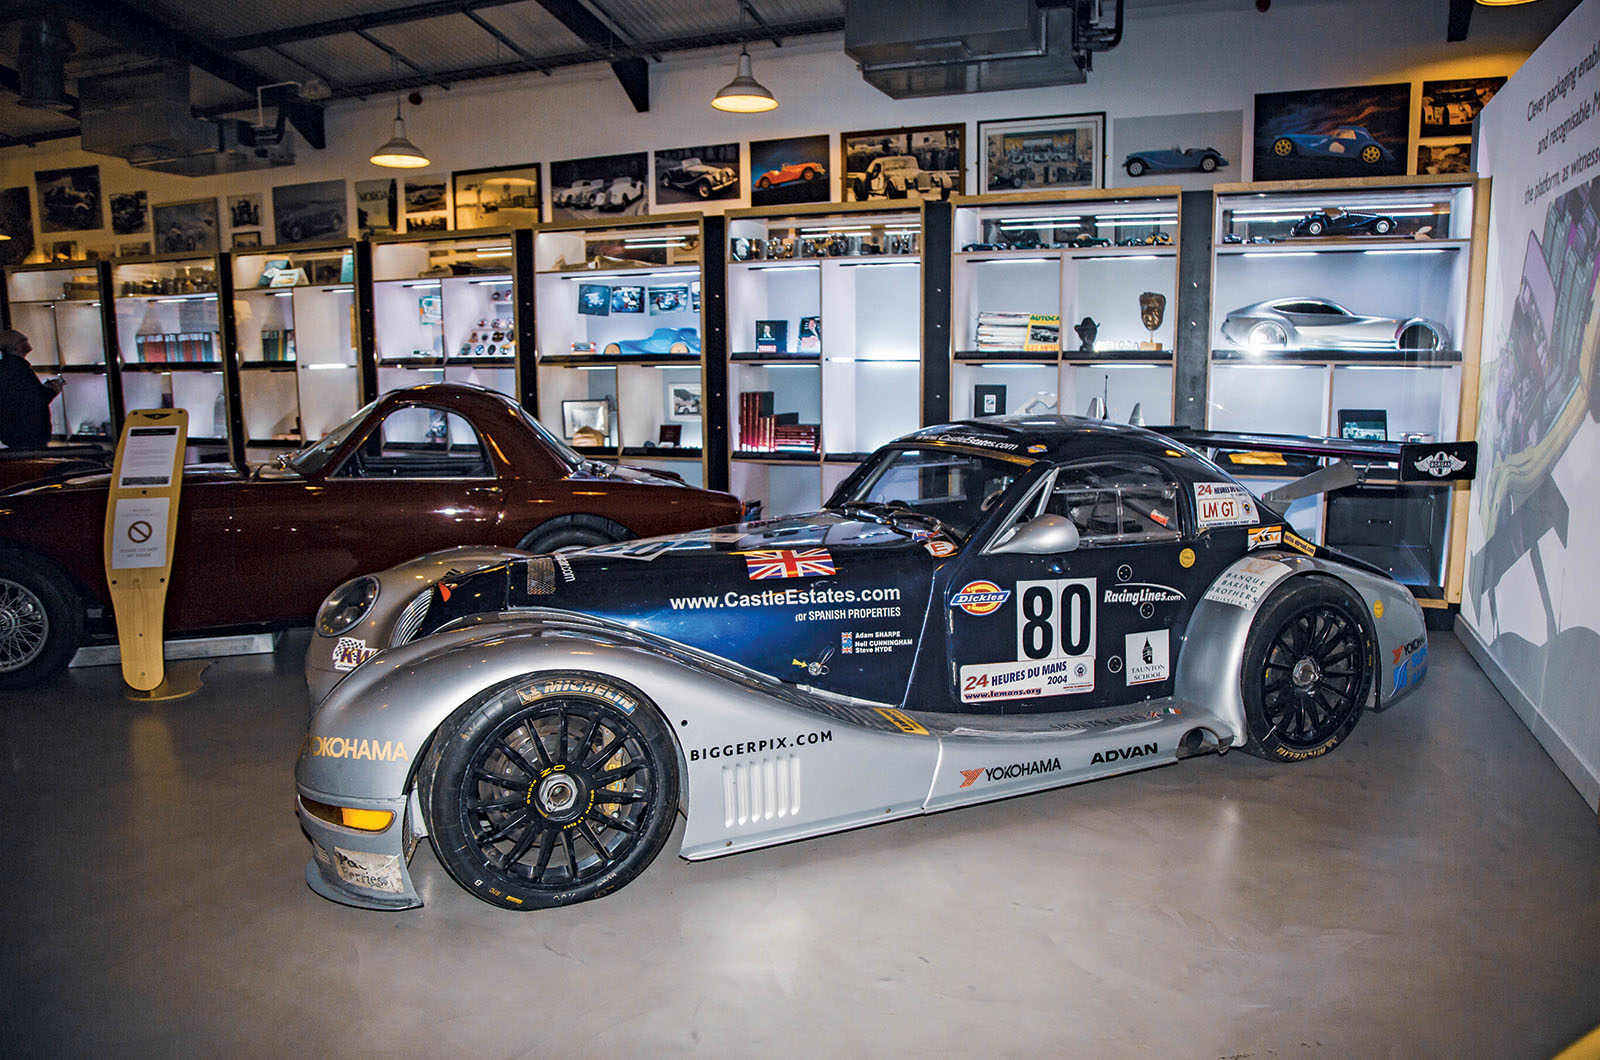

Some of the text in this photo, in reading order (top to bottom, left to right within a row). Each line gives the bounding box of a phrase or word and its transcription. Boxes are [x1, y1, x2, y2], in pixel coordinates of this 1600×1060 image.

[1527, 95, 1545, 122] Clever
[1547, 66, 1577, 112] packaging
[1538, 129, 1549, 155] and
[1549, 99, 1590, 143] recognisable
[1524, 185, 1533, 205] the
[1562, 167, 1569, 183] as
[1198, 485, 1212, 496] 24
[1203, 501, 1233, 518] LM GT
[1222, 580, 1258, 593] BARING
[1225, 572, 1266, 587] BANQUE
[670, 588, 901, 610] www.CastleEstates.com
[957, 593, 1004, 602] Dickies
[1104, 588, 1181, 605] RacingLines.com
[1210, 586, 1259, 604] BROTHERS
[808, 609, 847, 621] SPANISH
[848, 606, 901, 620] PROPERTIES
[1022, 583, 1092, 660] 80
[869, 638, 913, 647] CUNNINGHAM
[875, 630, 901, 638] SHARPE
[964, 660, 1067, 691] 24 HEURES DU MANS
[1131, 664, 1165, 674] TAUNTON
[1134, 672, 1162, 681] SCHOOL
[1047, 675, 1068, 685] 2004
[544, 679, 636, 710] MICHELIN
[964, 687, 1042, 700] www.lemans.org
[690, 730, 834, 762] BIGGERPIX.COM
[1090, 742, 1159, 766] ADVAN
[985, 757, 1062, 782] YOKOHAMA
